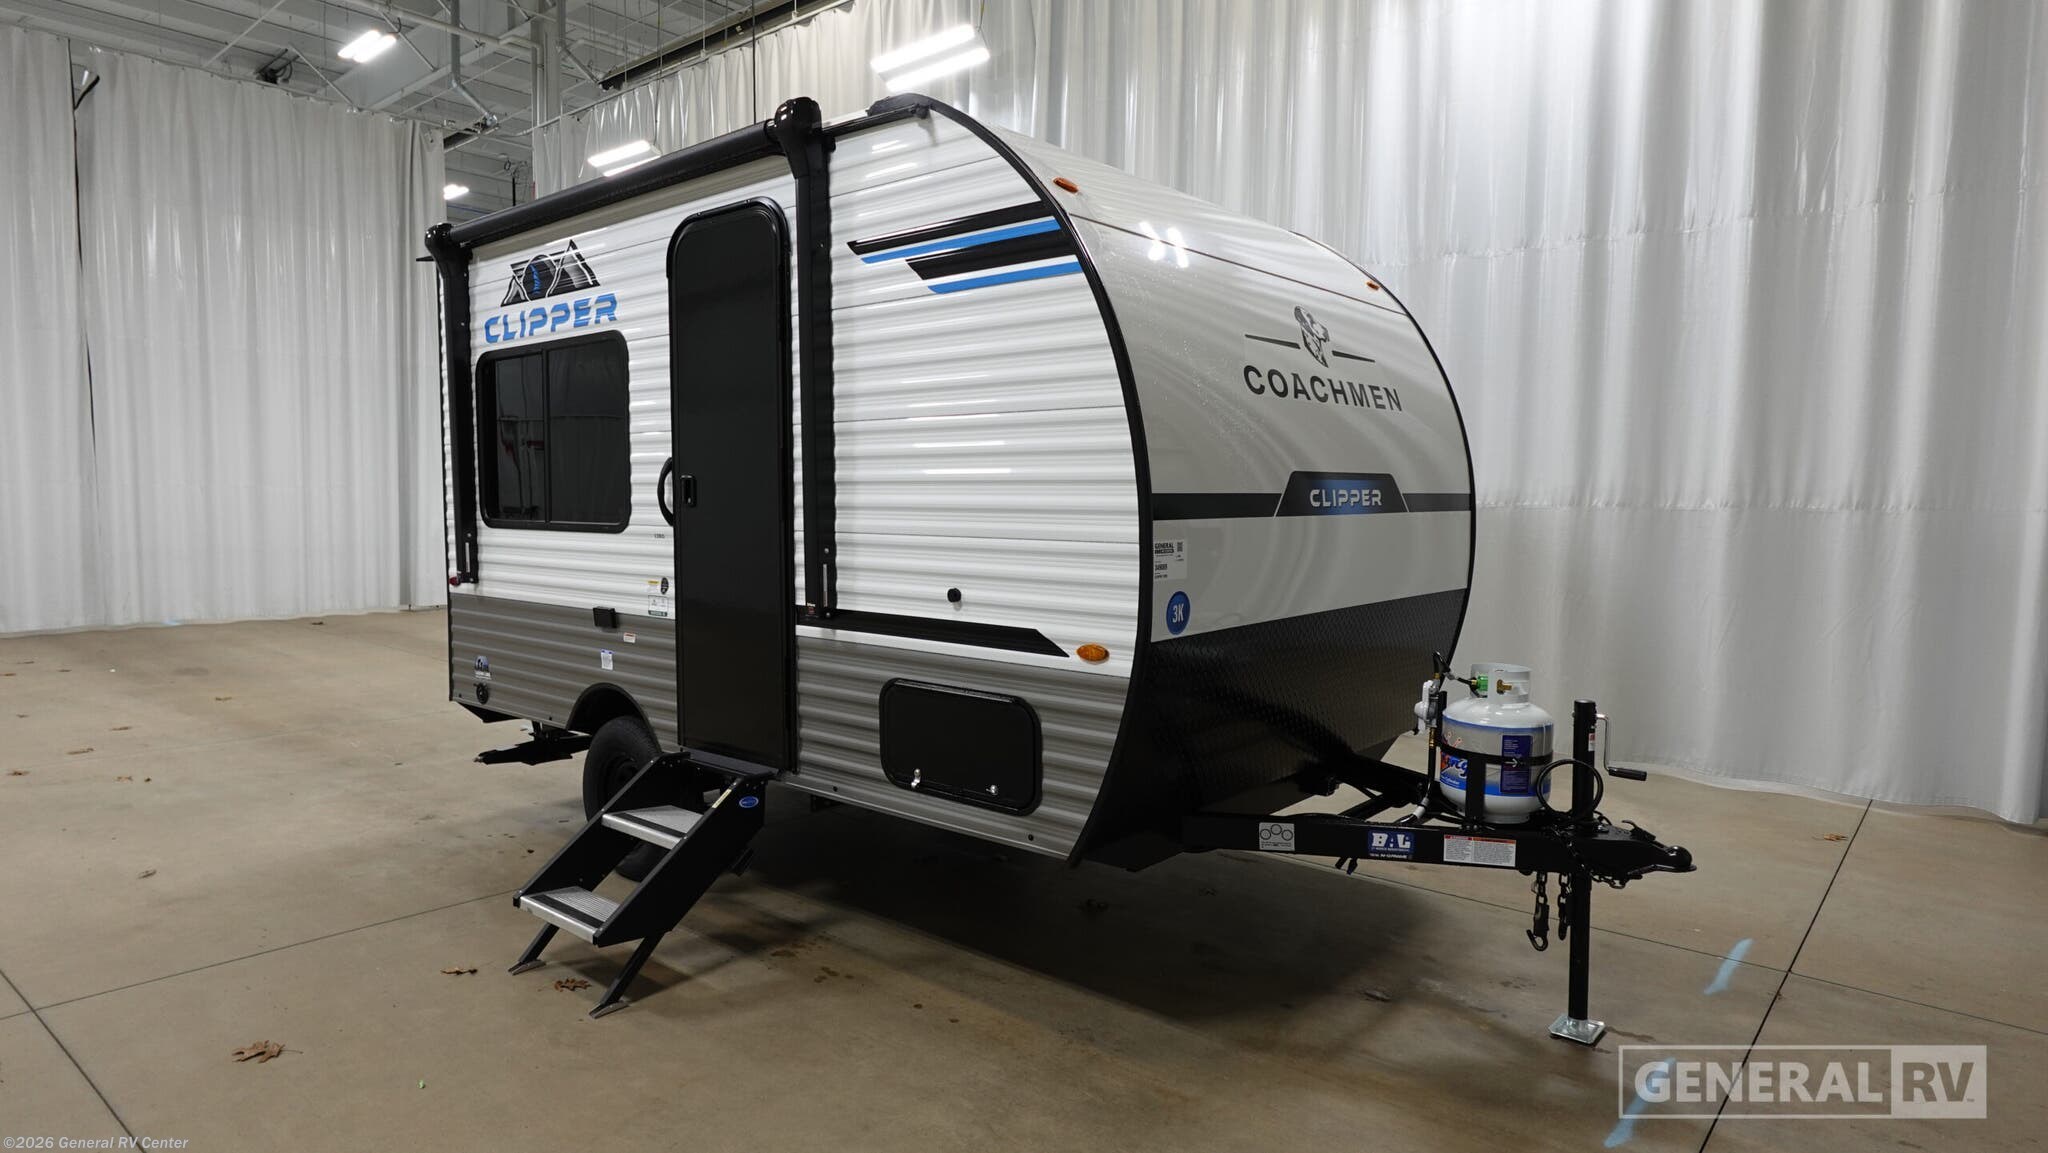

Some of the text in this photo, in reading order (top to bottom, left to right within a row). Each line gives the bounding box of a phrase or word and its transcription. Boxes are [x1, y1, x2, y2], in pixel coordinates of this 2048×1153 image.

[484, 293, 618, 344] CLIPPER
[1243, 365, 1403, 412] COACHMEN
[1309, 488, 1383, 508] CLIPPER
[1172, 603, 1185, 623] 3K
